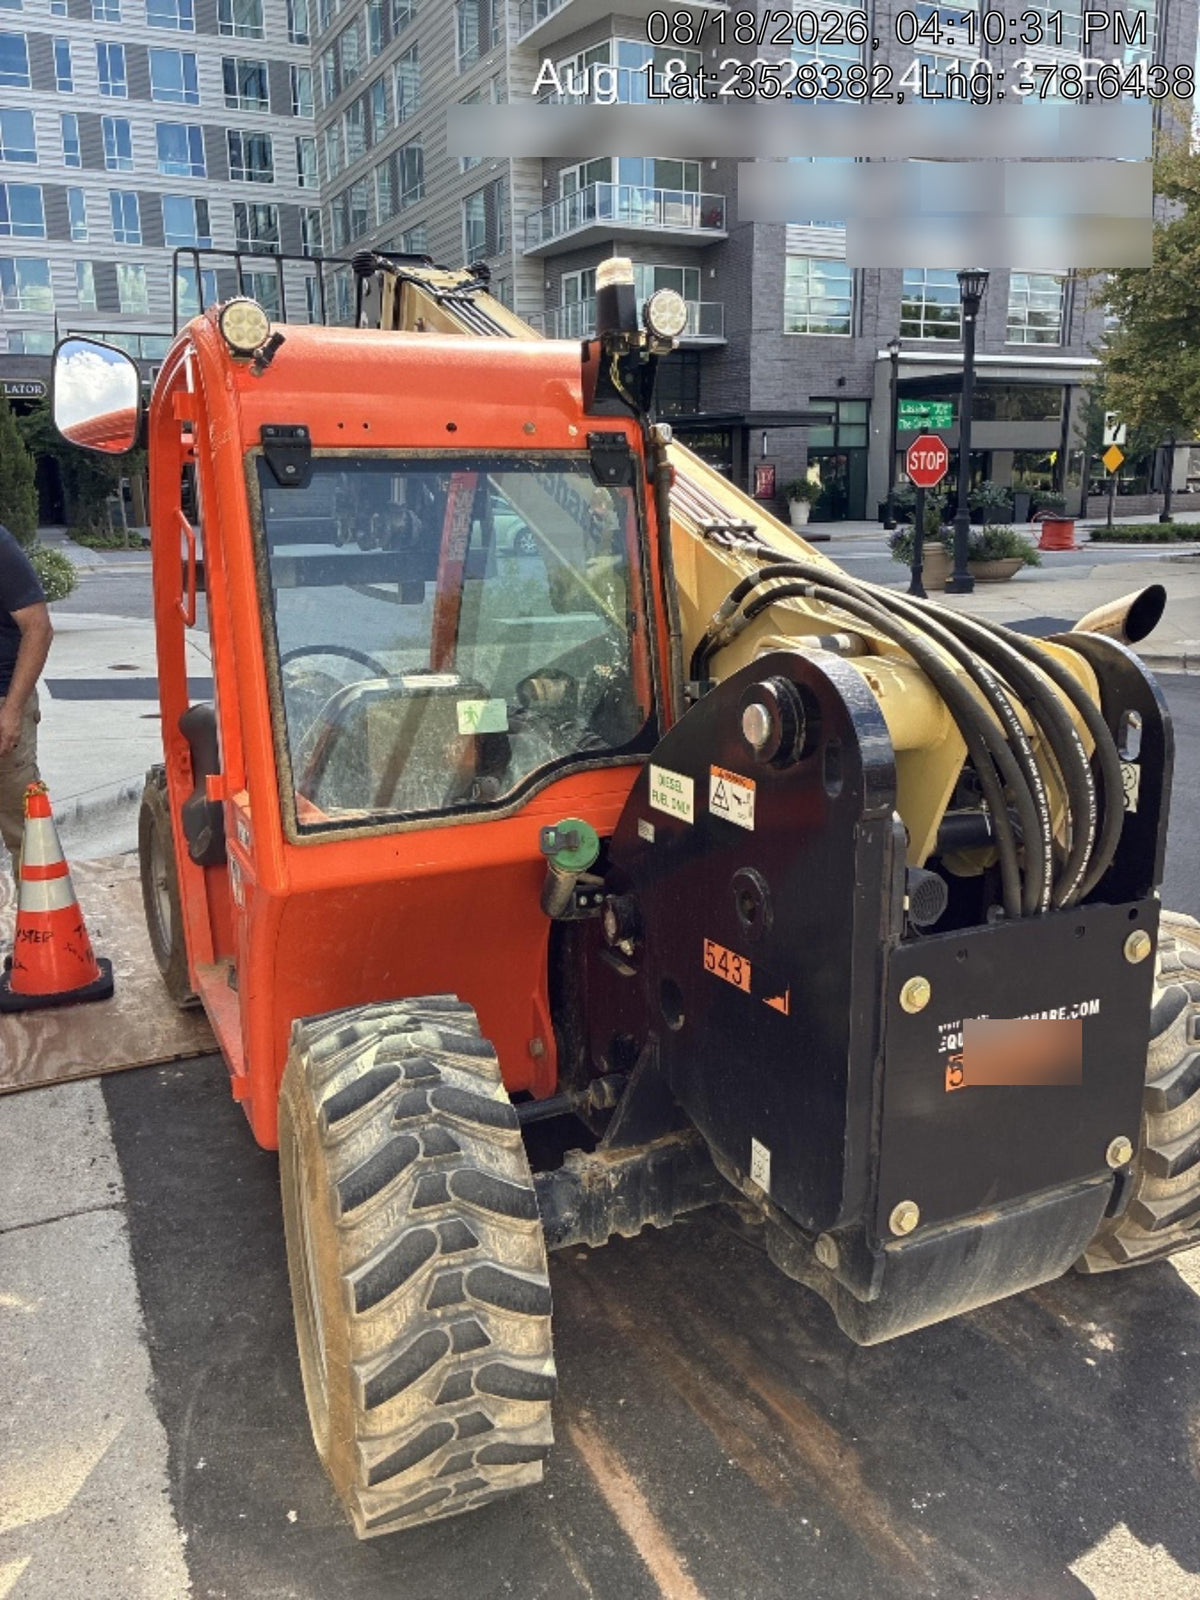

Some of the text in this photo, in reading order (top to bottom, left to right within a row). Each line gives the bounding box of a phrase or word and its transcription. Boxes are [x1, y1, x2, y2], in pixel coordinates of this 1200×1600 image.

[4, 384, 43, 394] LATOR
[910, 451, 945, 470] STOP
[705, 941, 751, 985] 543
